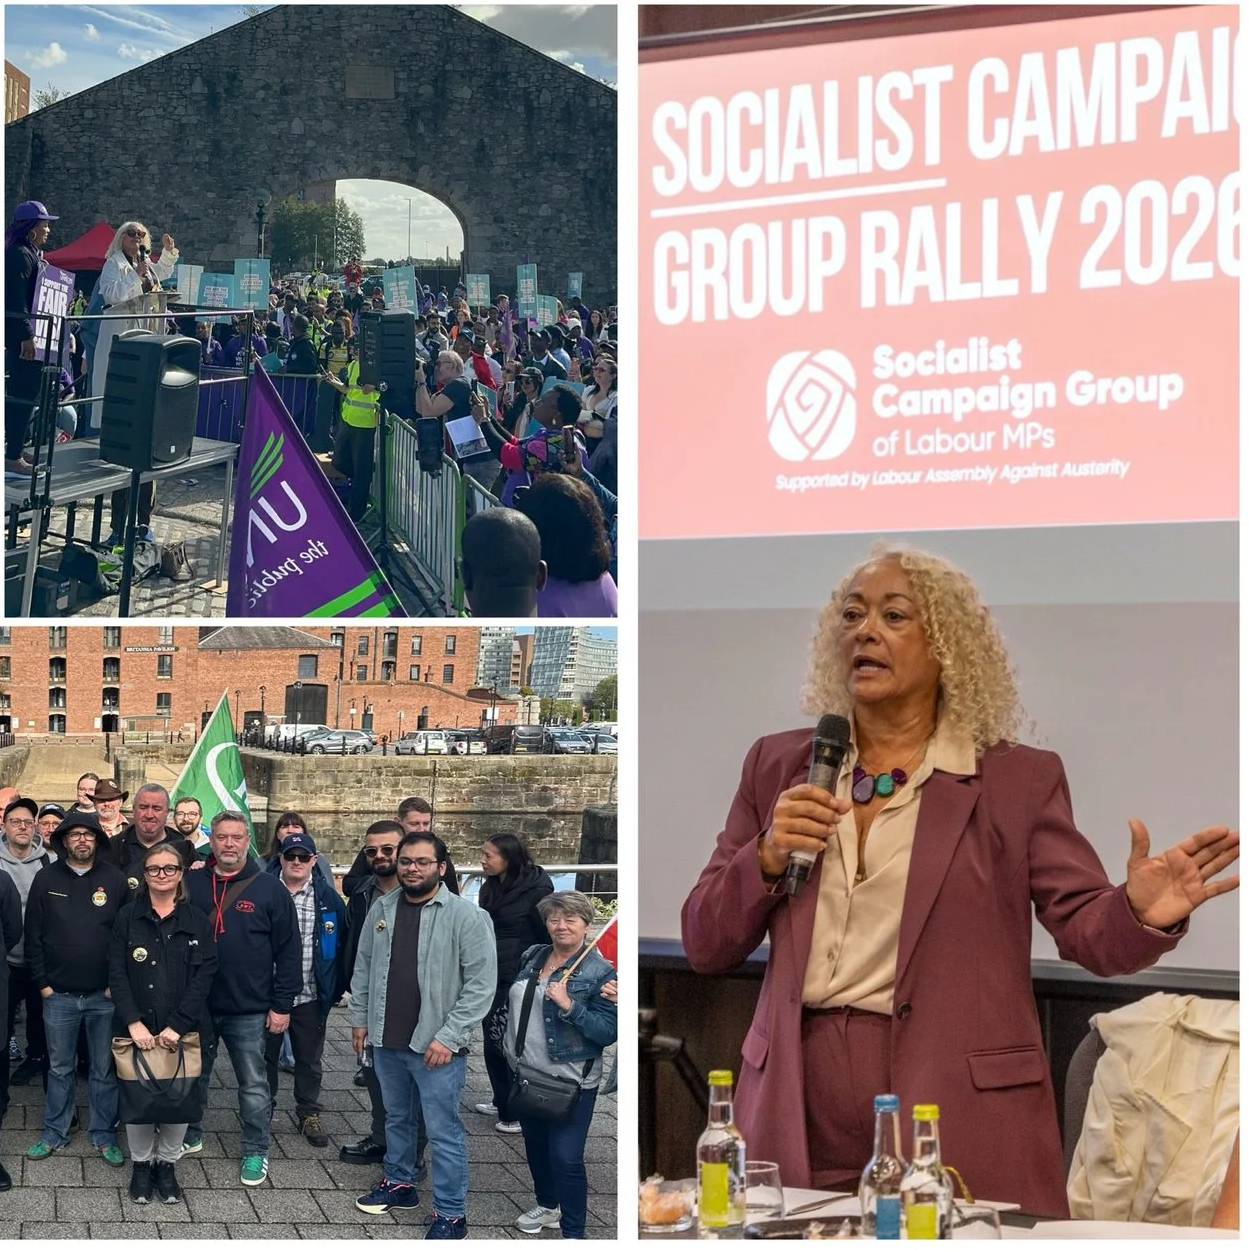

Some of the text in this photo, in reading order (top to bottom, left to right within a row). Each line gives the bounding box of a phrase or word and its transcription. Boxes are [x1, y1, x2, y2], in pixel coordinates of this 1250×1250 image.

[652, 64, 954, 197] SOCIALIST
[653, 170, 1240, 325] GROUP RALLY 2026
[37, 286, 68, 316] FAIR
[872, 336, 1022, 379] Socialist
[872, 369, 1184, 422] Campaign Group
[873, 422, 1055, 458] of Labour MPs
[775, 459, 1131, 493] Supported by Labour Assembly Against Austerity
